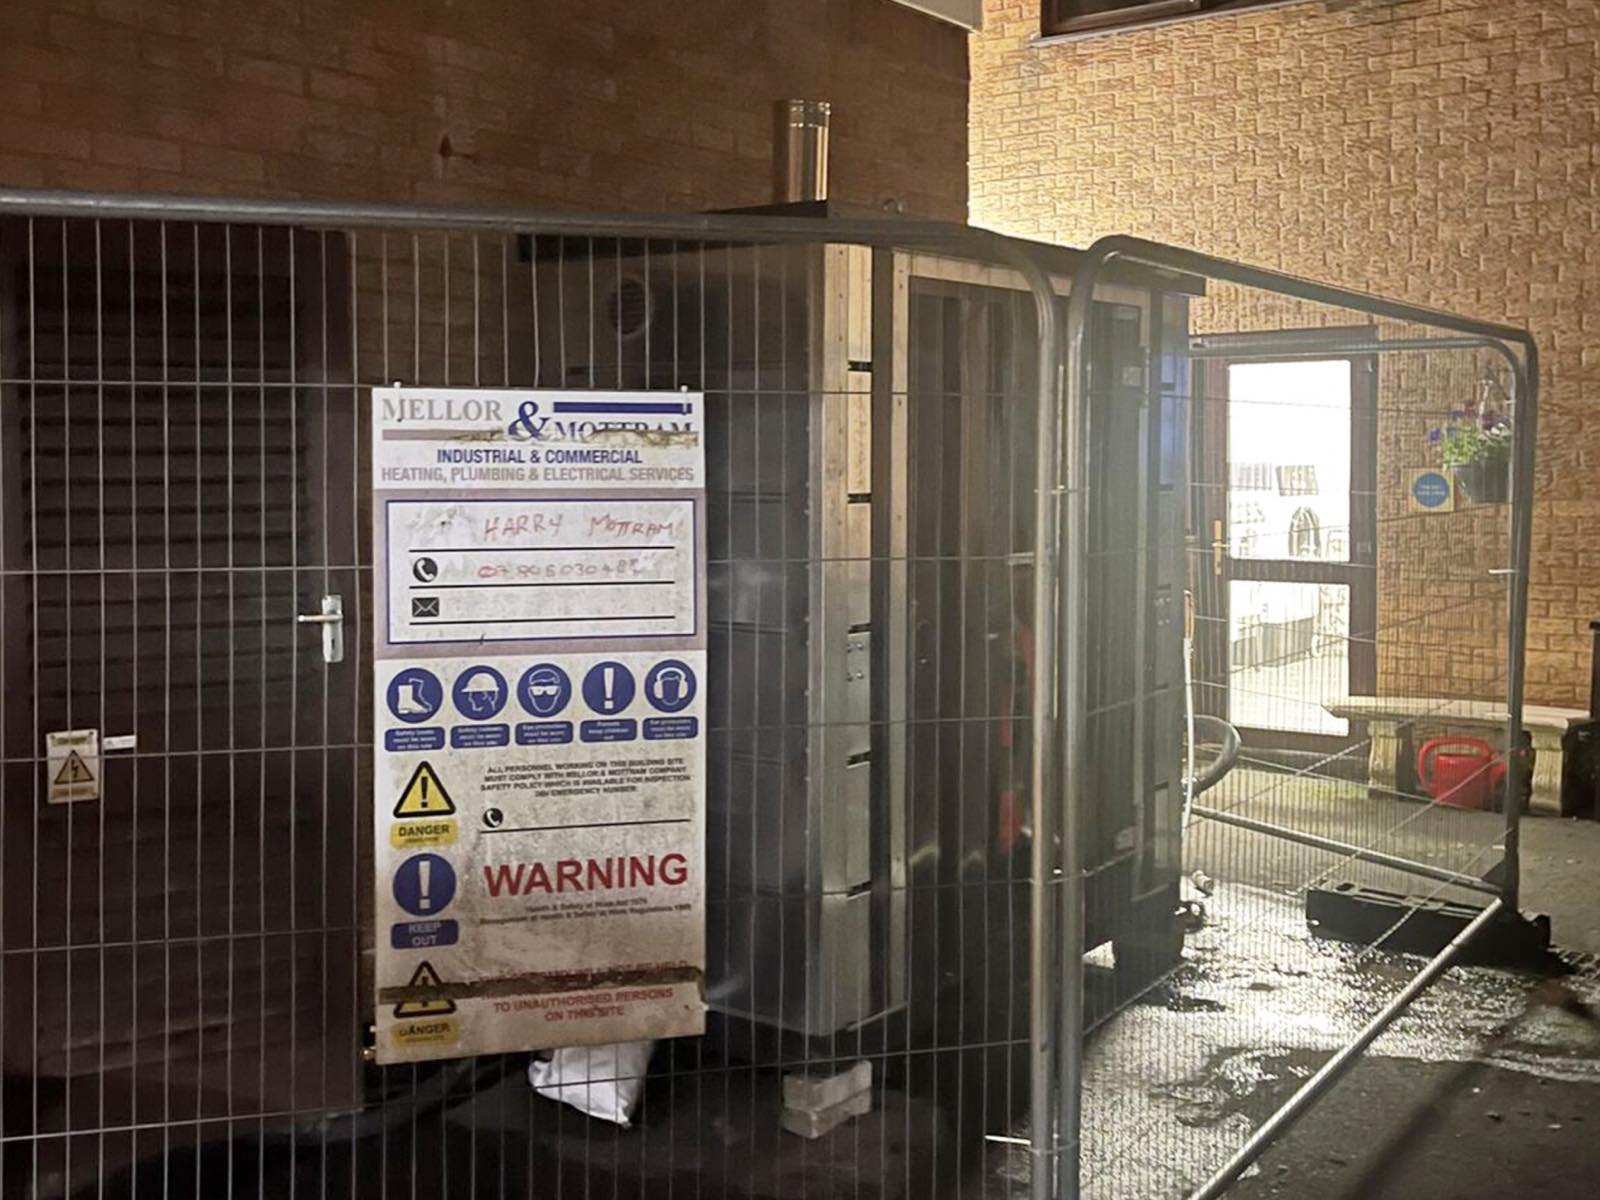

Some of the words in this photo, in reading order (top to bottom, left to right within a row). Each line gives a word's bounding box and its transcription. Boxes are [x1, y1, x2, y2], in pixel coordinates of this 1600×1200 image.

[383, 398, 503, 421] MELLOR
[508, 401, 551, 441] &
[437, 449, 526, 463] INDUSTRIAL
[530, 450, 541, 463] &
[545, 450, 643, 464] COMMERCIAL
[382, 467, 447, 483] HEATING,
[451, 467, 524, 482] PLUMBING
[528, 468, 539, 481] &
[543, 467, 625, 481] ELECTRICAL
[629, 466, 694, 481] SERVICES
[484, 513, 563, 541] HARRY
[588, 514, 674, 538] MOTTRAM
[484, 774, 506, 782] MUST
[508, 773, 542, 781] COMPLY
[649, 766, 686, 774] COMPANY
[505, 764, 552, 772] PERSONNEL
[555, 761, 594, 770] WORKING
[480, 783, 512, 791] SAFETY
[513, 781, 543, 789] POLICY
[544, 779, 572, 788] WHICH
[582, 777, 624, 786] AVAILABLE
[645, 775, 691, 783] INSPECTION
[551, 787, 600, 796] EMERGENCY
[398, 824, 449, 837] DANGER
[484, 853, 688, 897] WARNING
[408, 921, 441, 934] KEEP
[412, 935, 437, 946] OUT
[494, 1001, 511, 1013] TO
[615, 987, 673, 1002] PERSONS
[544, 1011, 564, 1022] ON
